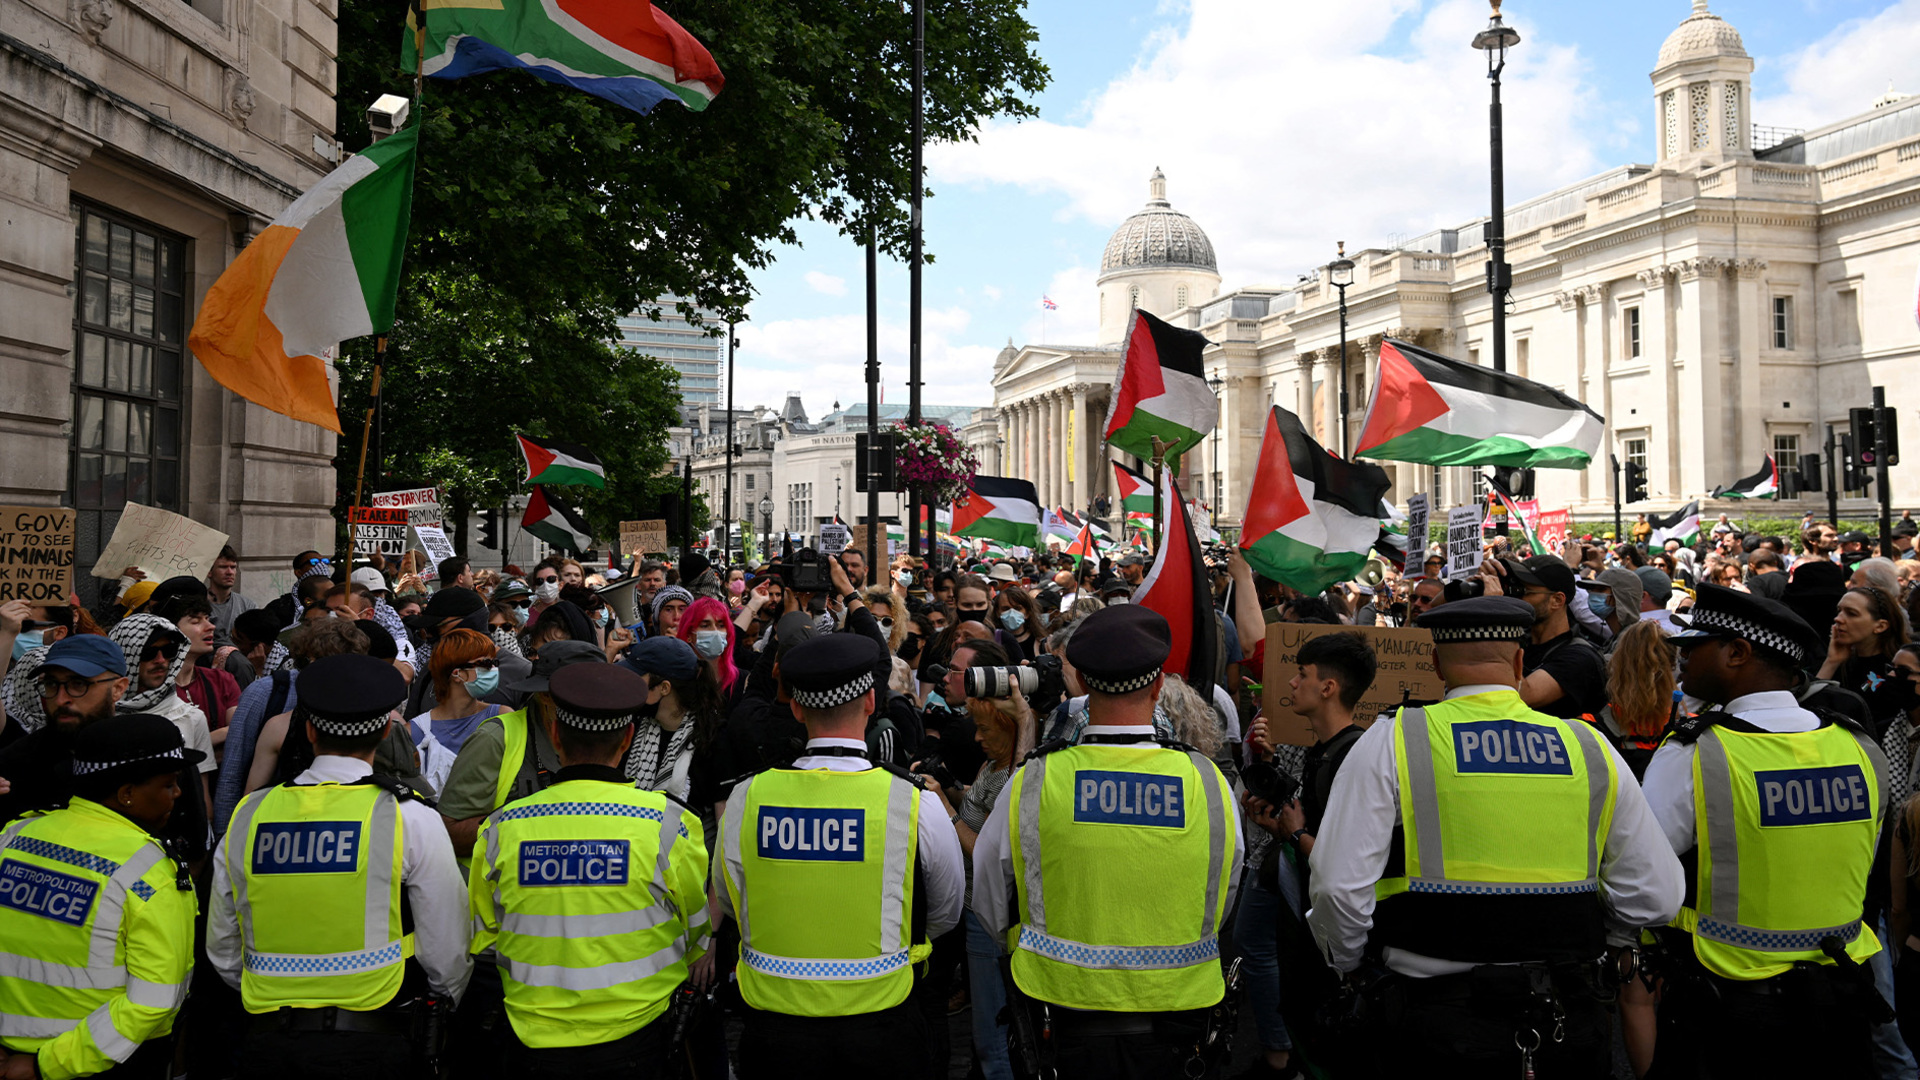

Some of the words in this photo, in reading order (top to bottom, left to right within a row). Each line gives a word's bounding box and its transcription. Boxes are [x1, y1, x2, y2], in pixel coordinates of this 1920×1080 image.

[372, 495, 391, 507] KEIR
[391, 488, 436, 507] STARVER
[15, 513, 70, 532] GOV:
[368, 509, 388, 522] ARE
[389, 510, 408, 522] ALL
[408, 508, 441, 523] ARMING
[22, 533, 40, 546] TO
[43, 534, 71, 546] SEE
[1467, 524, 1479, 539] OFF
[1450, 538, 1481, 557] PALESTINE
[16, 568, 33, 579] IN
[37, 568, 65, 580] THE
[169, 554, 198, 577] FOR
[1415, 661, 1436, 672] KIDS
[1460, 729, 1565, 765] POLICE
[1080, 779, 1179, 817] POLICE
[1764, 775, 1865, 816] POLICE
[762, 815, 858, 852] POLICE
[257, 830, 354, 864] POLICE
[524, 844, 624, 856] METROPOLITAN
[523, 858, 623, 881] POLICE
[4, 863, 93, 897] METROPOLITAN
[0, 877, 88, 921] POLICE
